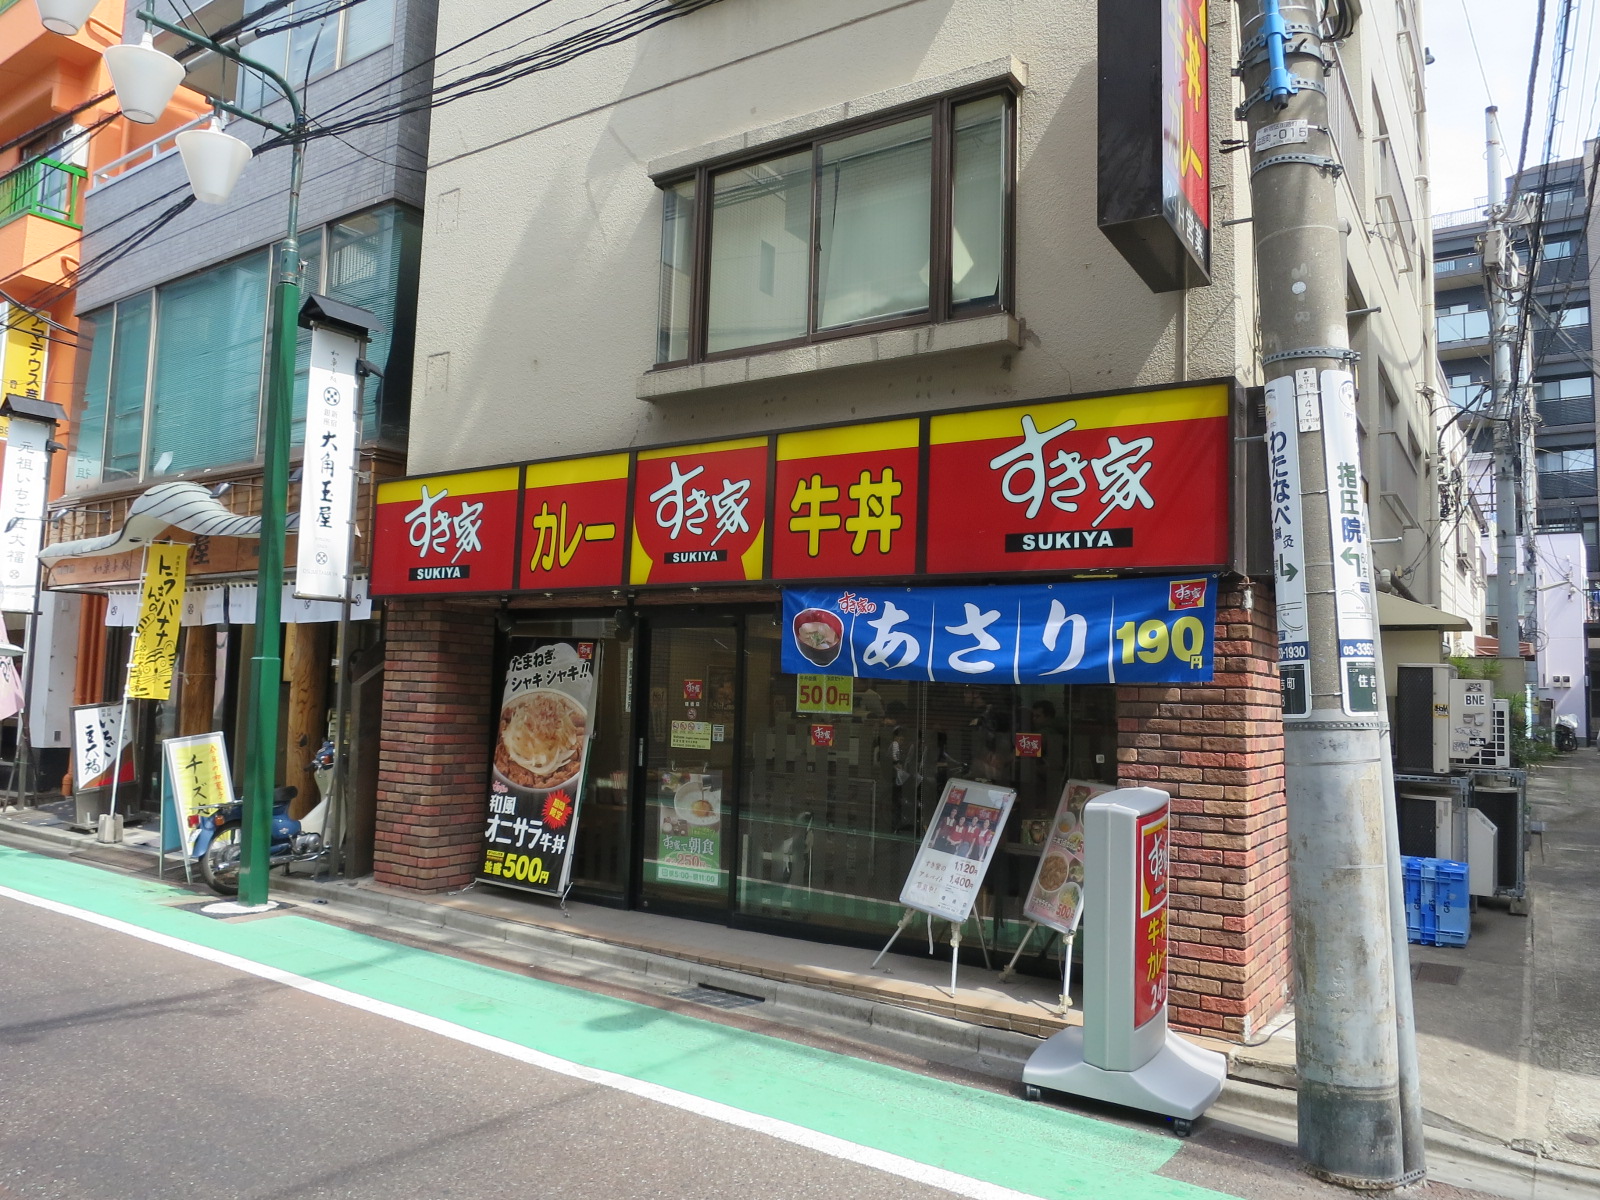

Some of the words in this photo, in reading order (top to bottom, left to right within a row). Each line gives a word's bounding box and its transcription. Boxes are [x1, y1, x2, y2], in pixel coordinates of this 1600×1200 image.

[989, 413, 1156, 528] すき家
[1269, 430, 1292, 525] わたなべ
[649, 461, 751, 546] すき家
[789, 466, 903, 558] 牛丼
[1336, 461, 1362, 544] 指圧院
[404, 484, 484, 564] すき家
[530, 501, 616, 572] カレー
[1022, 530, 1113, 551] SUKIYA
[672, 550, 718, 563] SUKIYA
[416, 566, 461, 580] SUKIYA
[838, 591, 877, 617] すき家の
[511, 648, 557, 672] たまねぎ
[1342, 642, 1374, 656] 03-335
[1465, 695, 1485, 705] BNE
[489, 793, 517, 816] 和風
